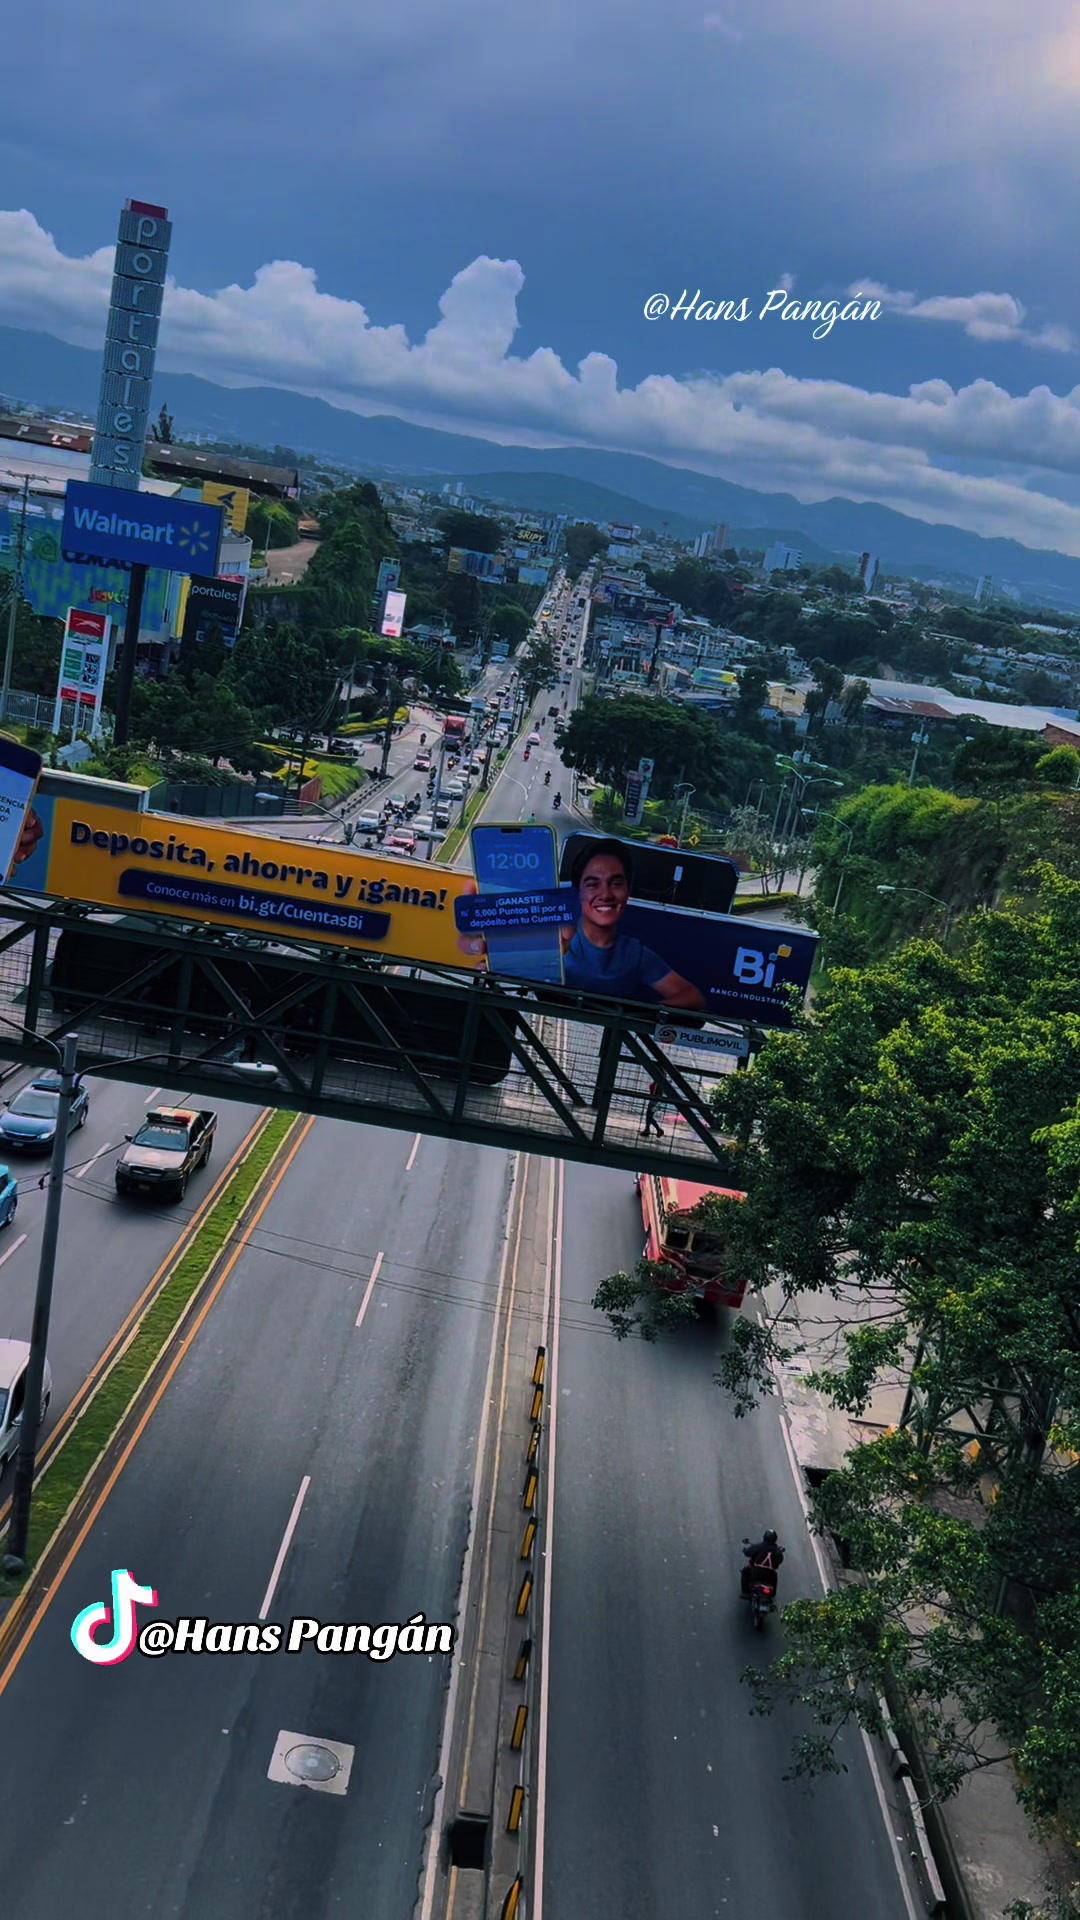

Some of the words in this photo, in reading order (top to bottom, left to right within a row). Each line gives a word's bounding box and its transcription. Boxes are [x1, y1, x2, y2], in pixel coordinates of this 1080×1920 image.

[113, 216, 158, 465] portales
[73, 506, 175, 545] Walmart
[191, 584, 238, 602] portales
[70, 820, 215, 873] Deposita,
[223, 852, 329, 890] ahorra
[334, 874, 354, 898] y
[357, 878, 448, 911] ¡gana!
[487, 852, 540, 869] 12:00
[146, 882, 190, 899] Conoce
[192, 891, 218, 905] más
[219, 897, 235, 907] en
[238, 895, 364, 930] bi.gt/CuentasBi
[495, 895, 544, 907] ¡GANASTE!
[470, 915, 506, 928] depósito
[520, 916, 530, 924] tu
[531, 914, 562, 924] Cuenta
[563, 913, 573, 921] Bi
[475, 908, 497, 918] 5,000
[499, 906, 528, 916] Puntos
[530, 905, 540, 913] Bi
[542, 905, 556, 915] por
[558, 904, 566, 912] el
[733, 946, 778, 988] Bi
[710, 987, 738, 998] BANCO
[740, 993, 789, 1006] INDUSTRIA
[679, 1031, 743, 1051] PUBLIMOVIL
